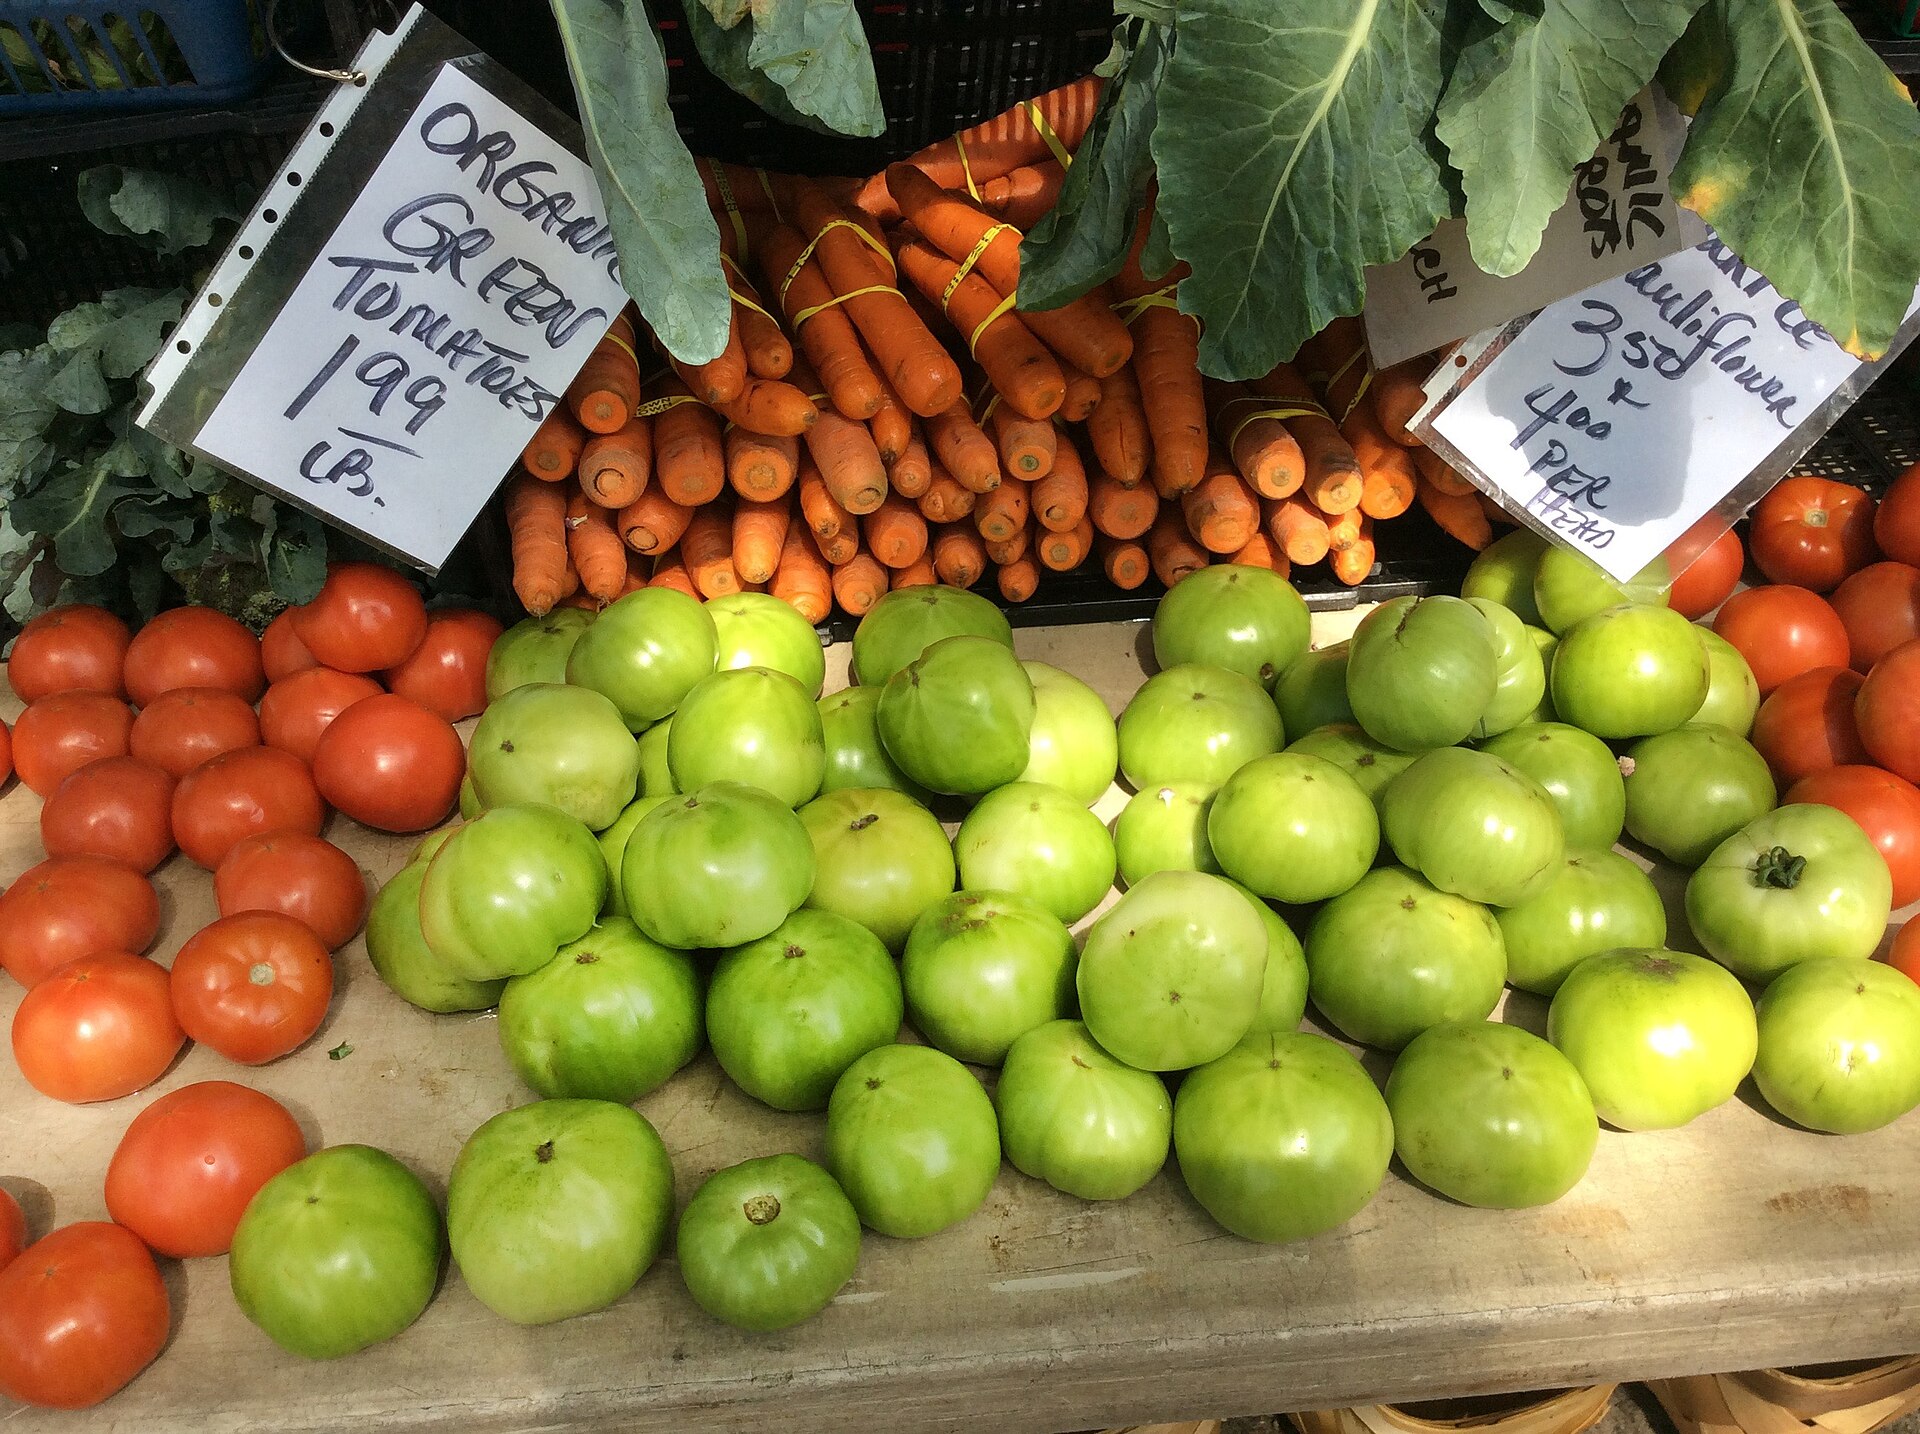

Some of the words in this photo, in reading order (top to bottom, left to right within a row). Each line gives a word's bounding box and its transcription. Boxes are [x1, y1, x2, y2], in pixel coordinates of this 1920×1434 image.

[382, 193, 607, 349] GREEN
[1408, 235, 1458, 304] CH
[328, 256, 560, 422] TOMATOES
[1509, 382, 1612, 451] 400
[1524, 438, 1611, 509] PER
[1524, 486, 1616, 549] HEAD
